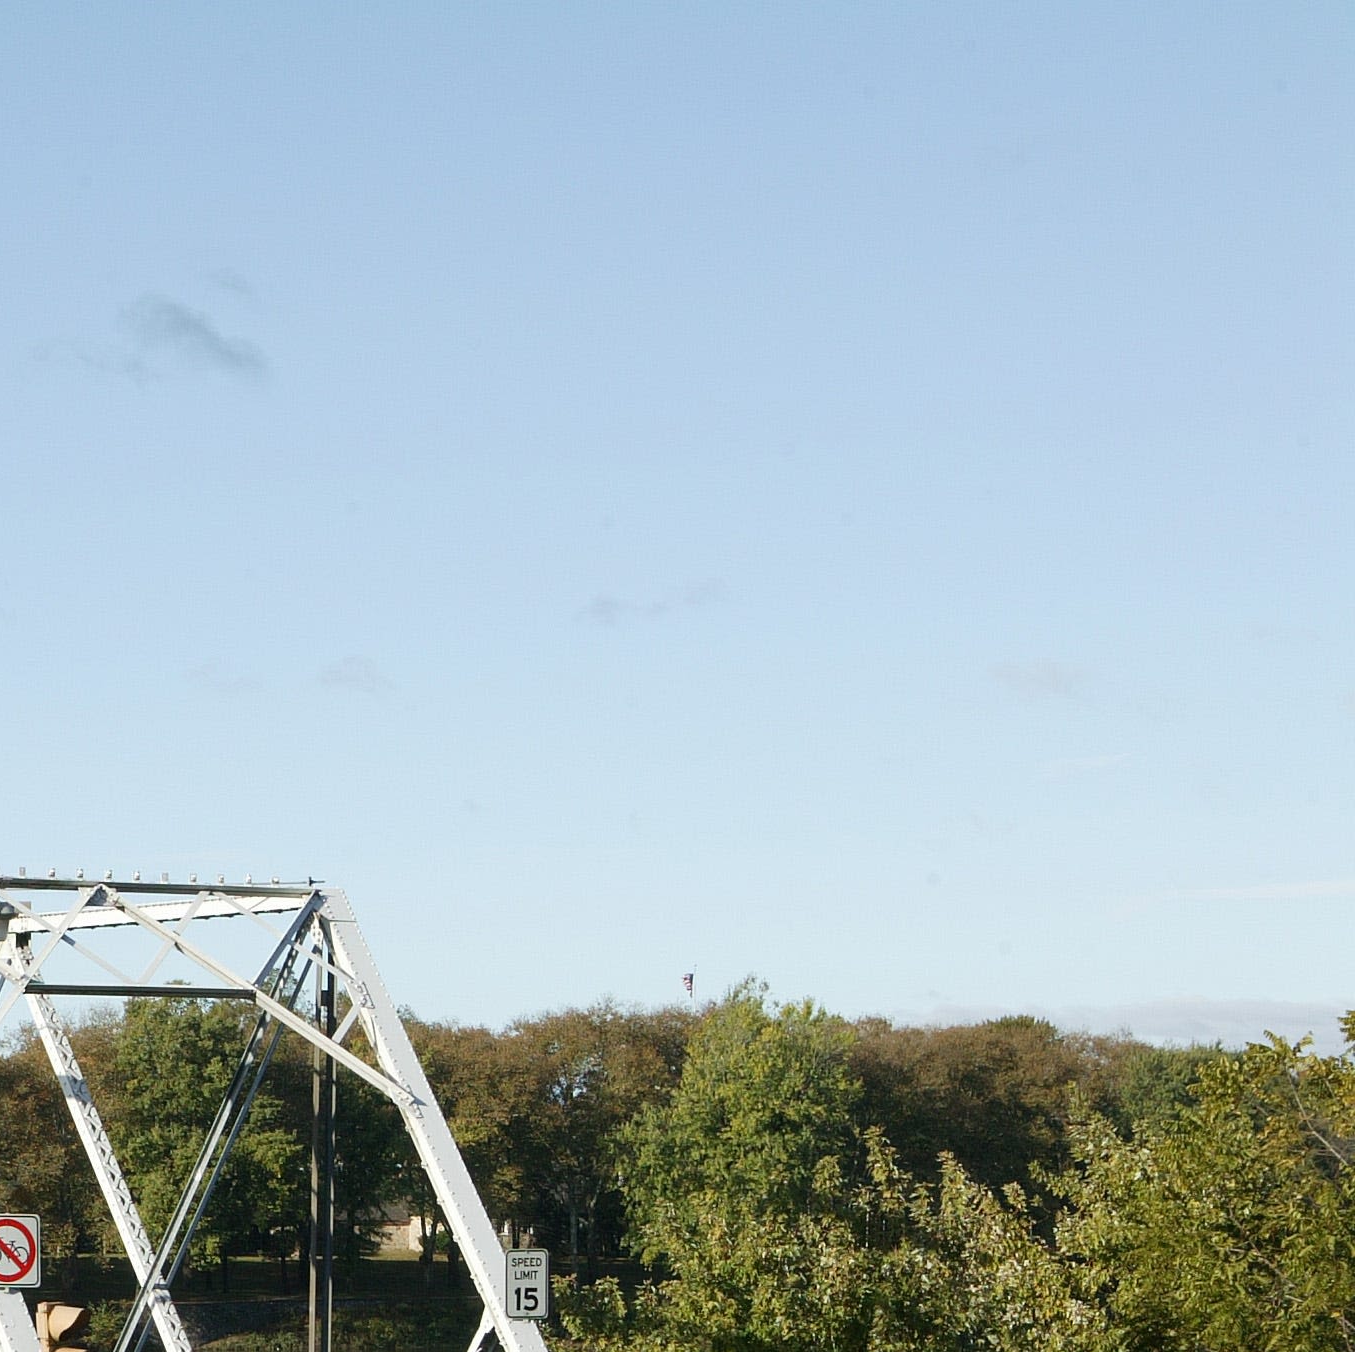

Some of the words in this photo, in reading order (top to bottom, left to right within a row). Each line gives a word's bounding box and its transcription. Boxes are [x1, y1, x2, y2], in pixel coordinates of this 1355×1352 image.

[511, 1257, 543, 1267] SPEED
[514, 1271, 539, 1280] LIMIT
[514, 1287, 539, 1311] 15
